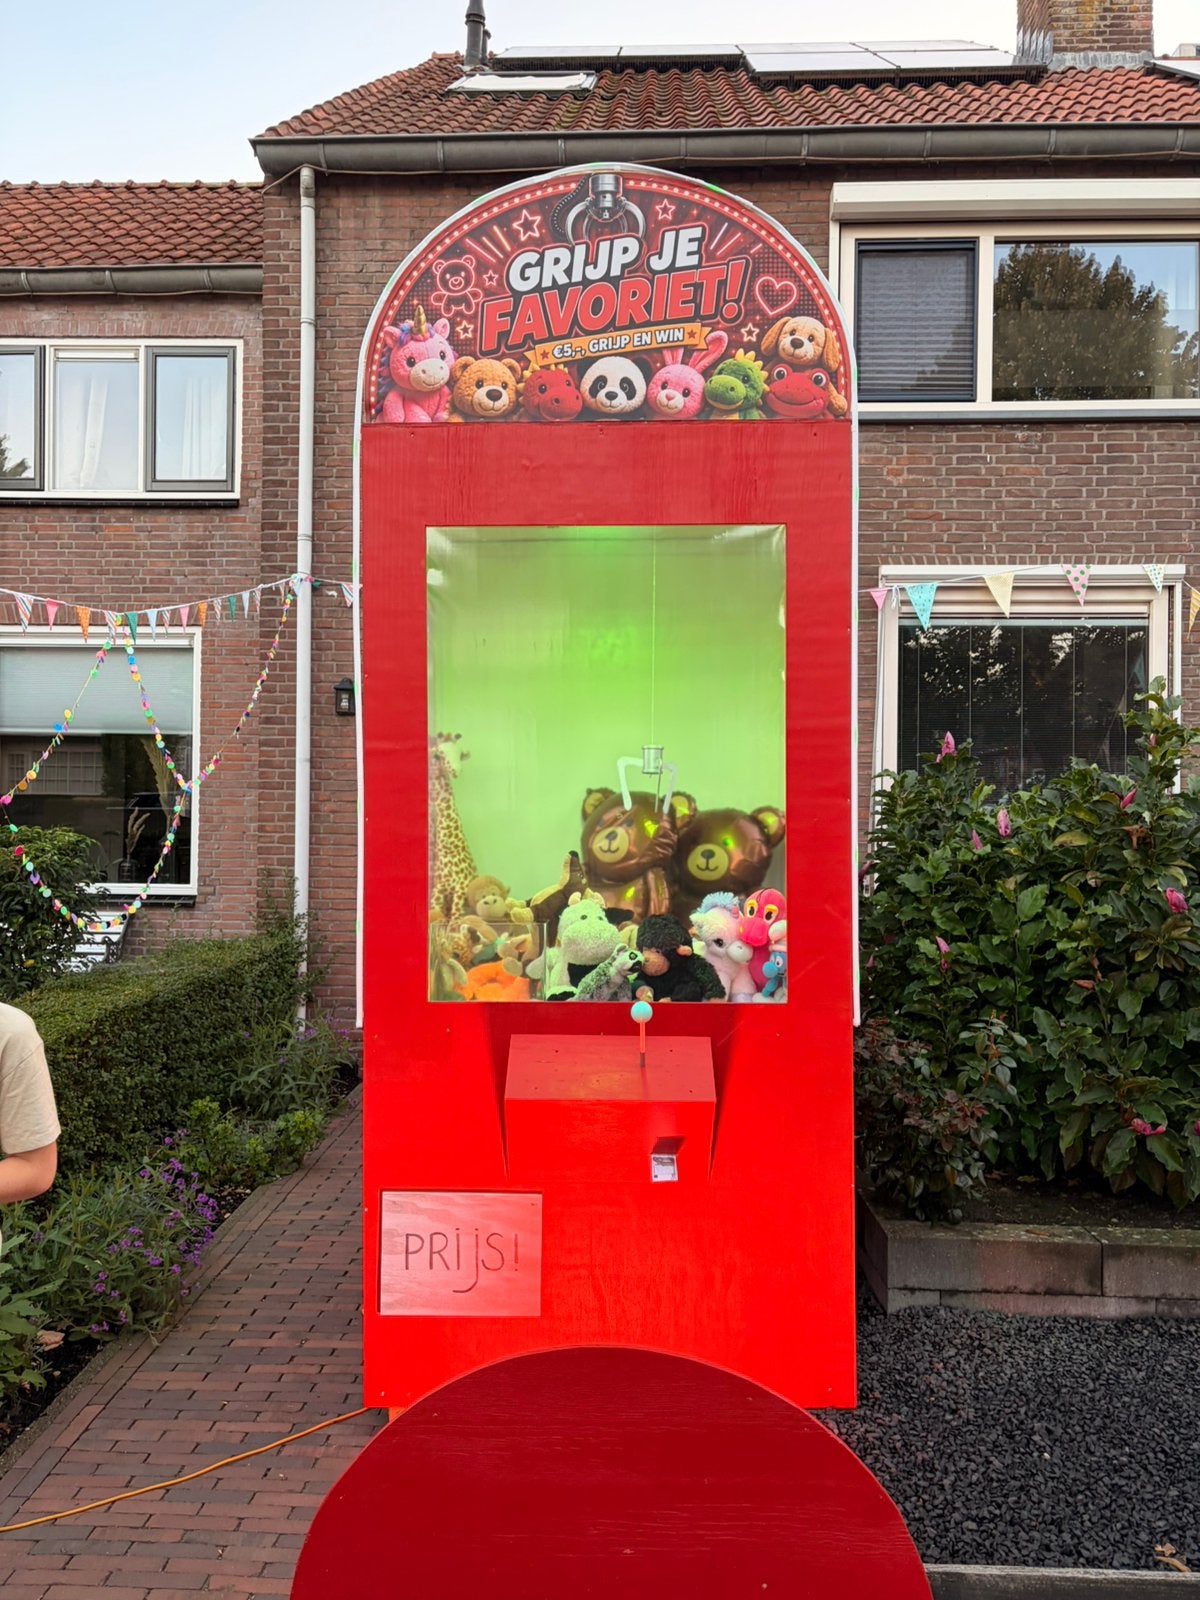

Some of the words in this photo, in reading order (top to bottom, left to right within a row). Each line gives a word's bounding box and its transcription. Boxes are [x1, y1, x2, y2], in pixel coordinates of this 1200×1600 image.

[508, 237, 640, 292] GRIJP
[649, 226, 703, 271] JE
[481, 259, 746, 352] FAVORIET!
[589, 337, 630, 353] GRIJP
[633, 333, 651, 347] EN
[655, 328, 683, 344] WIN
